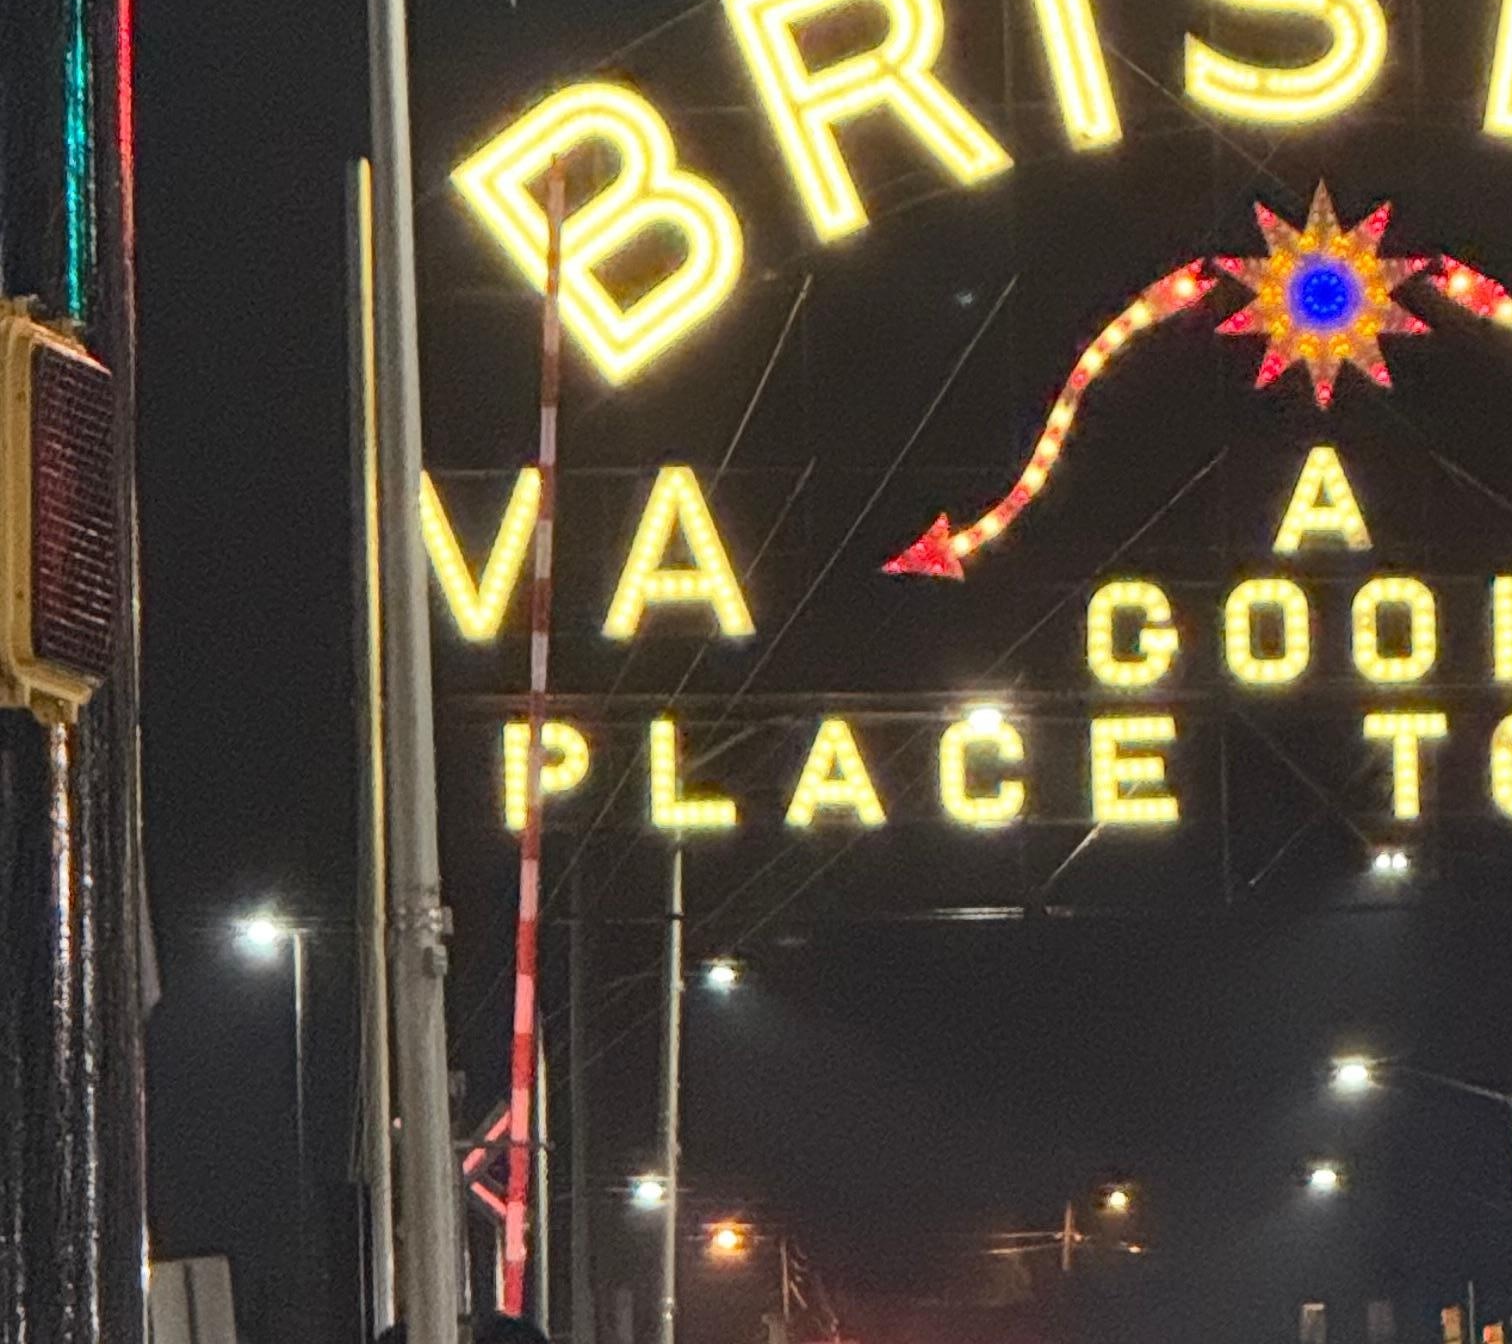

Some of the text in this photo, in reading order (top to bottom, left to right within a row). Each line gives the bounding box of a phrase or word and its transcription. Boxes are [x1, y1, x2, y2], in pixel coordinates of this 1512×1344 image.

[419, 465, 756, 641] VA
[1272, 446, 1373, 553] A
[503, 711, 1180, 831] PLACE
